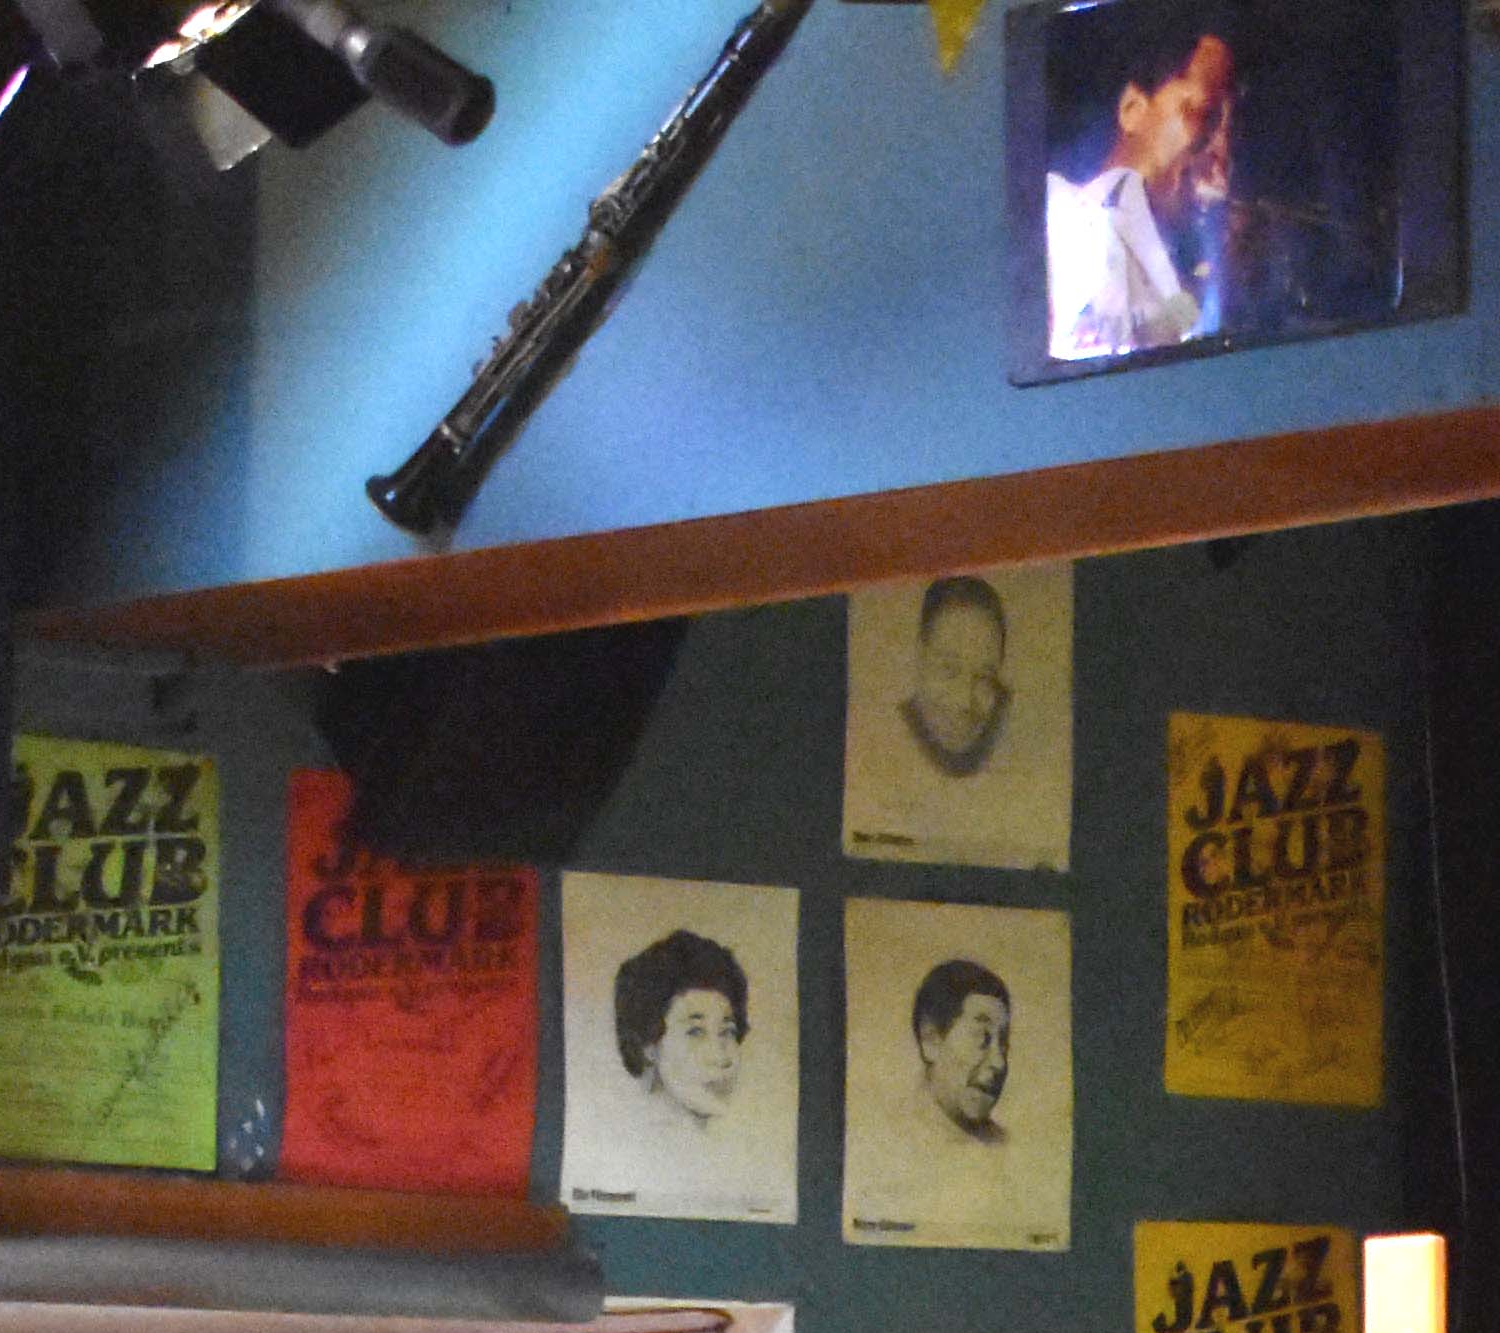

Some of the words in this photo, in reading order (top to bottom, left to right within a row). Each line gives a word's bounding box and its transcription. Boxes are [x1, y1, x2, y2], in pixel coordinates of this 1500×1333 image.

[1184, 738, 1361, 832] JAZZ
[1181, 805, 1368, 898] CLUB
[303, 876, 524, 948] CLUB
